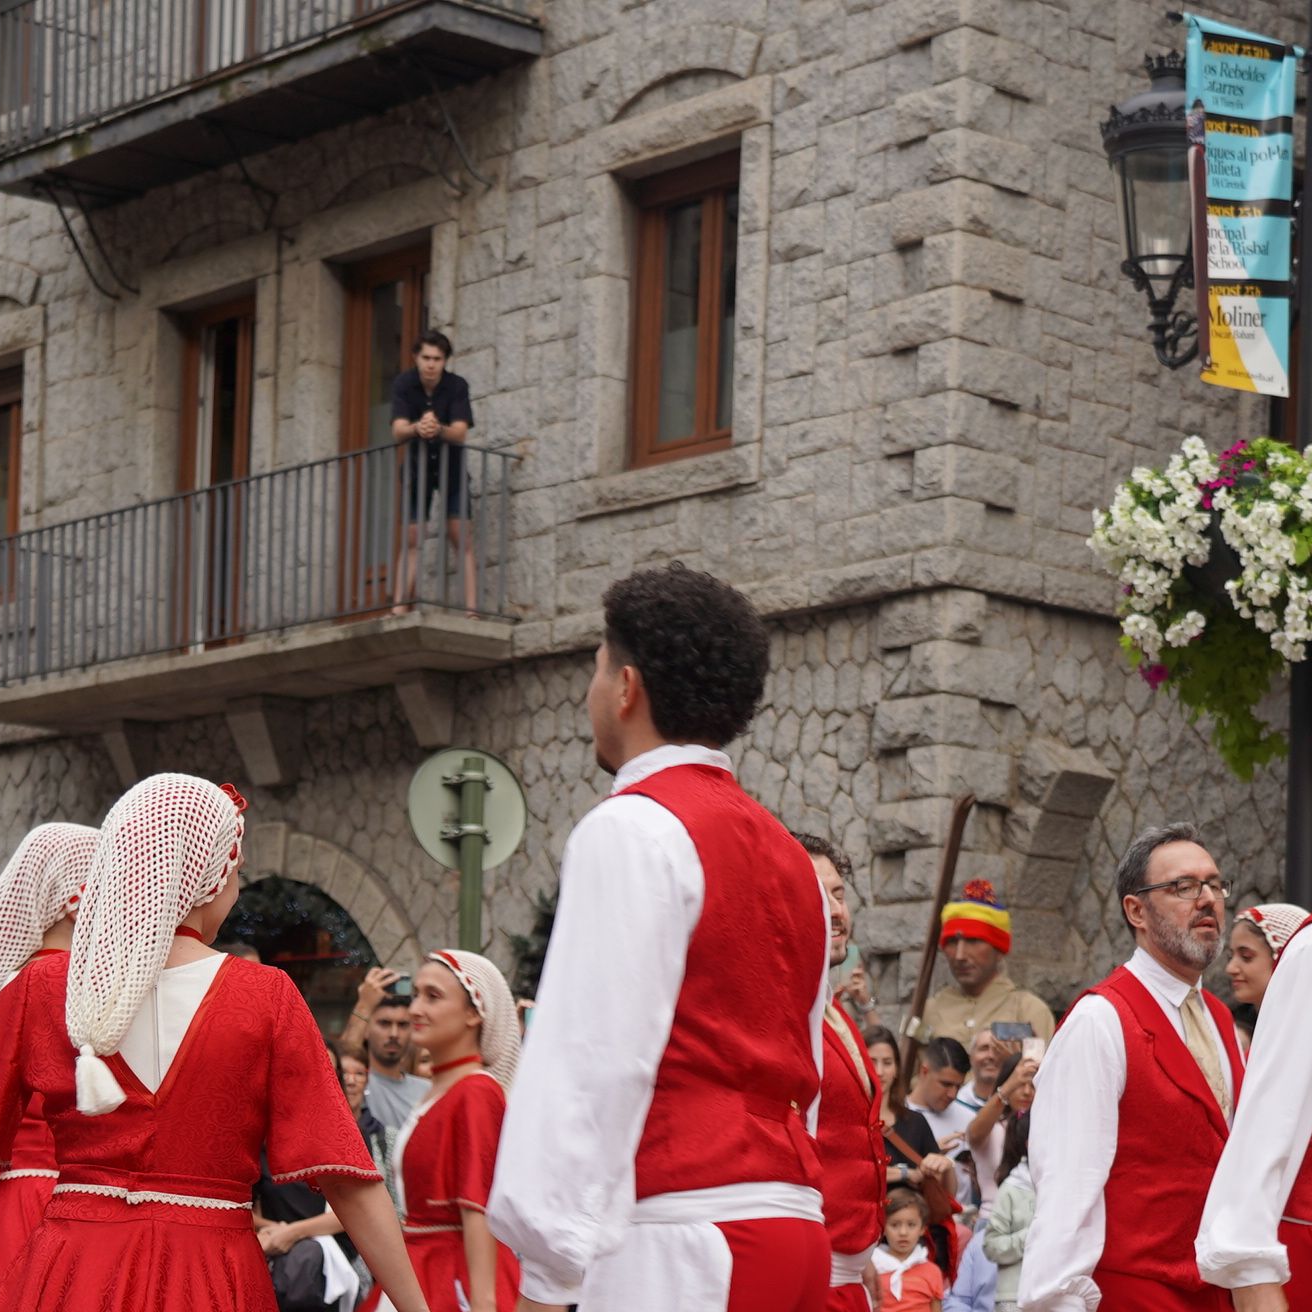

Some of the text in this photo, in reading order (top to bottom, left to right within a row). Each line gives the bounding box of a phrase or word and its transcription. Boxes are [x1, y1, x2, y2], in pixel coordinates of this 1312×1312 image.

[1207, 79, 1245, 97] atarres
[1207, 223, 1247, 244] incipal
[1232, 241, 1270, 257] Bisbal
